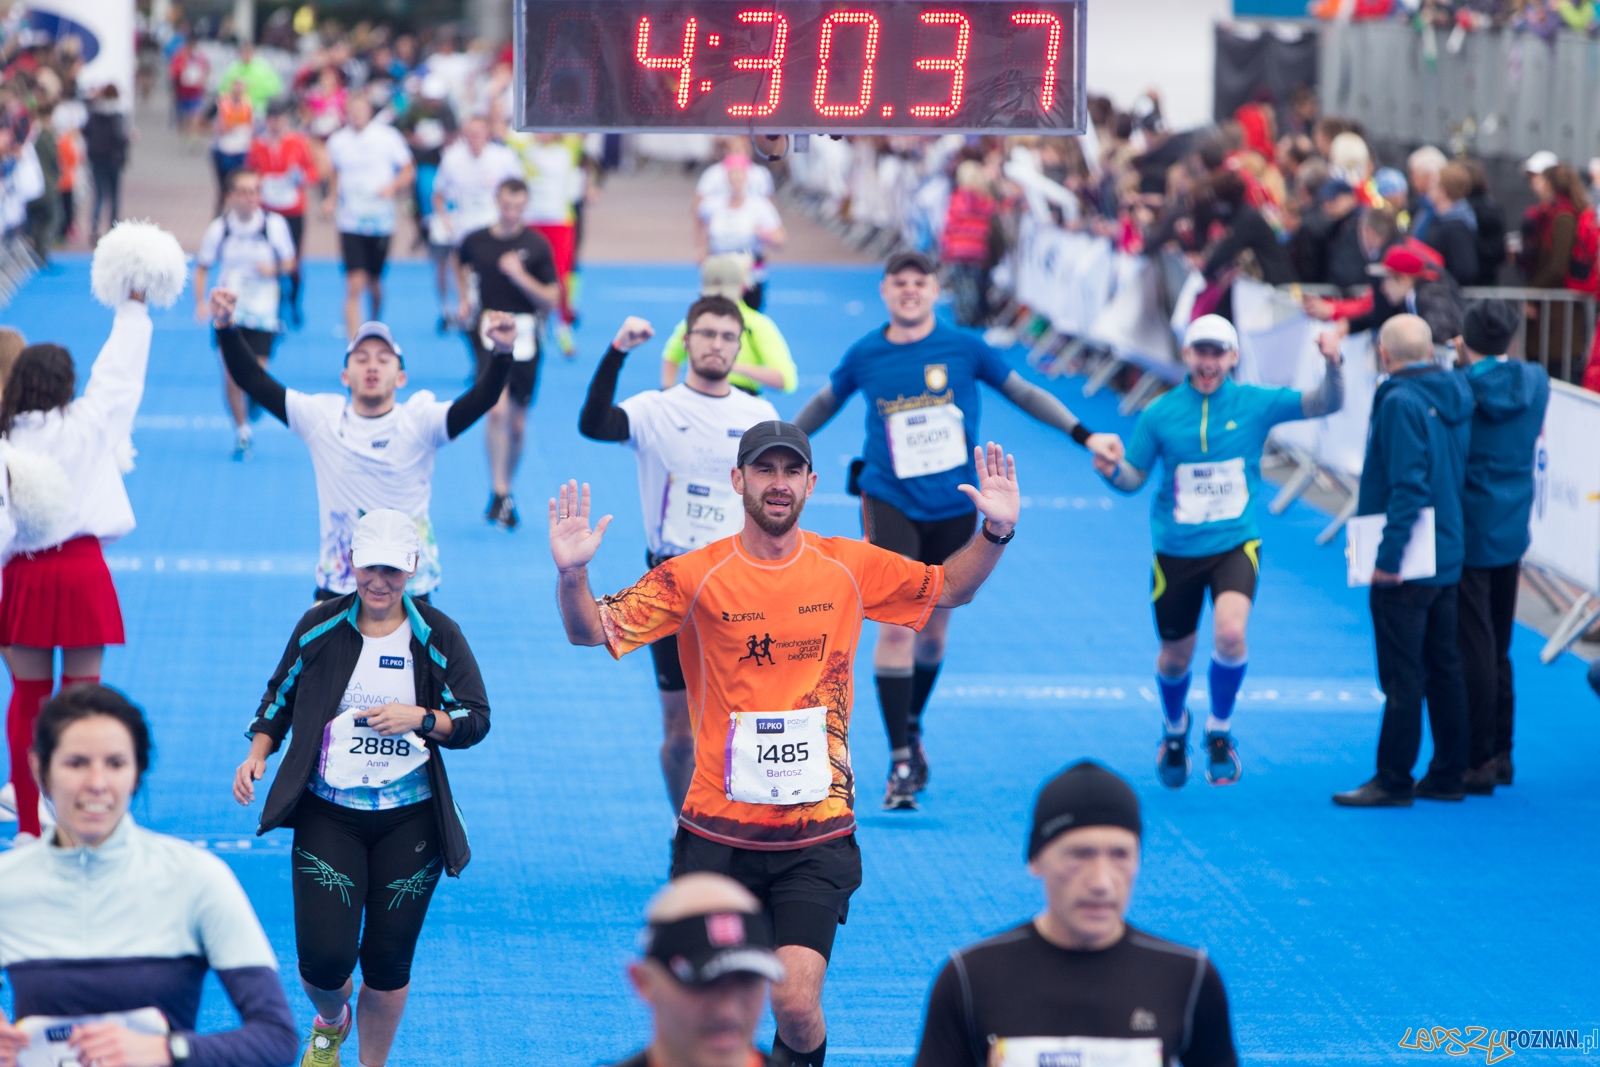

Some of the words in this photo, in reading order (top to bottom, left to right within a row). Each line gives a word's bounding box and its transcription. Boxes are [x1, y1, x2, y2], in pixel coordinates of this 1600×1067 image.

[636, 11, 1061, 117] 4:30.37
[686, 501, 725, 522] 1376
[798, 603, 834, 614] BARTEK
[731, 612, 766, 622] ZOFSTAL
[776, 637, 822, 649] miechowicka
[798, 644, 820, 654] grupa
[787, 651, 819, 661] biegowa
[349, 737, 411, 757] 2888
[756, 742, 809, 764] 1485
[366, 759, 389, 768] Anna
[766, 769, 803, 778] Bartosz
